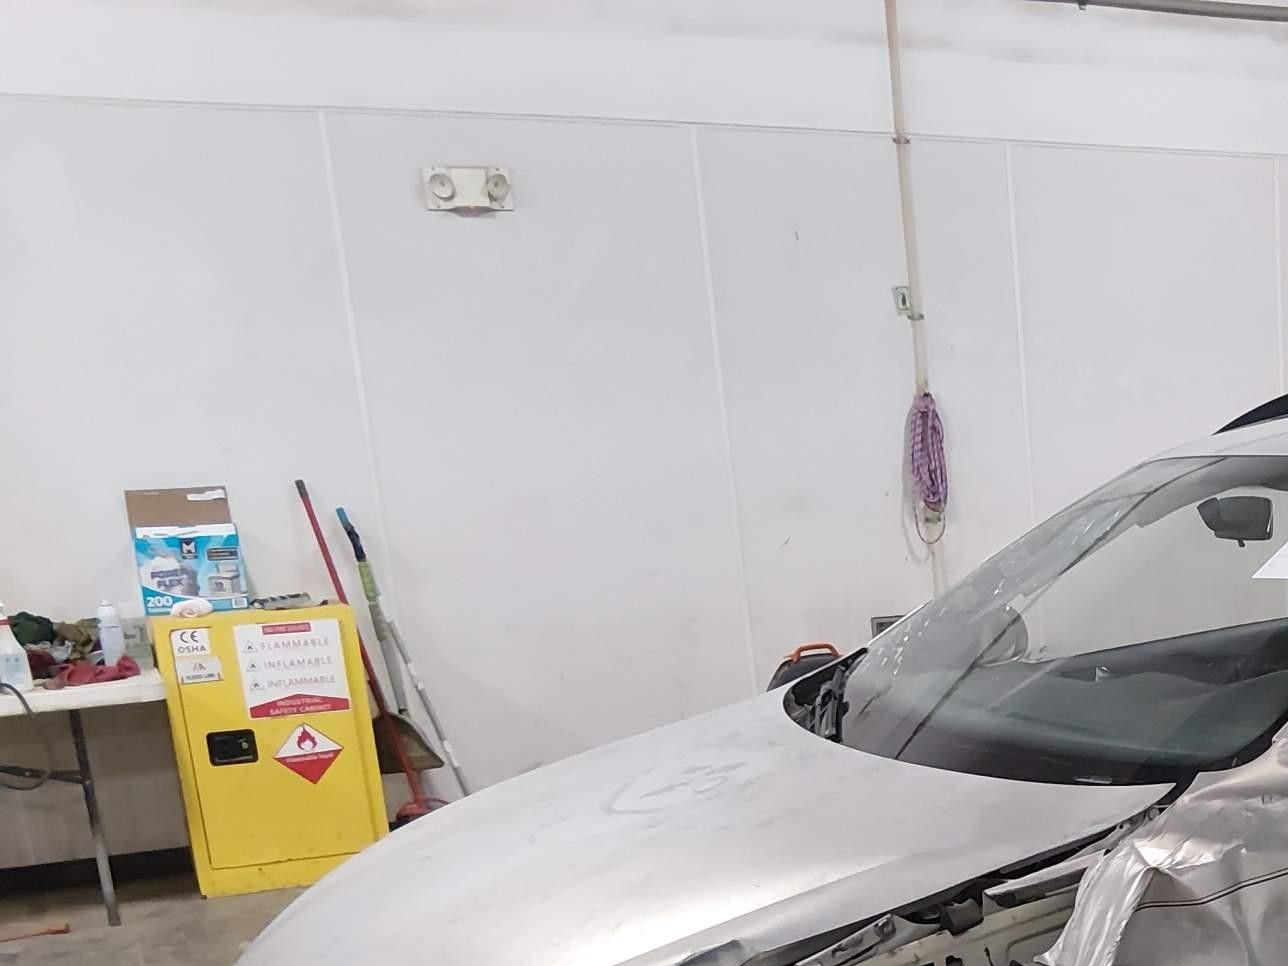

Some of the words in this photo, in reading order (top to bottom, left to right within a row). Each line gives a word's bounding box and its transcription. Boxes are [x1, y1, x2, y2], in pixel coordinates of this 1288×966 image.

[146, 596, 173, 608] 200
[177, 645, 207, 653] OSHA
[260, 638, 329, 650] FLAMMABLE
[263, 656, 333, 670] INFLAMABLE
